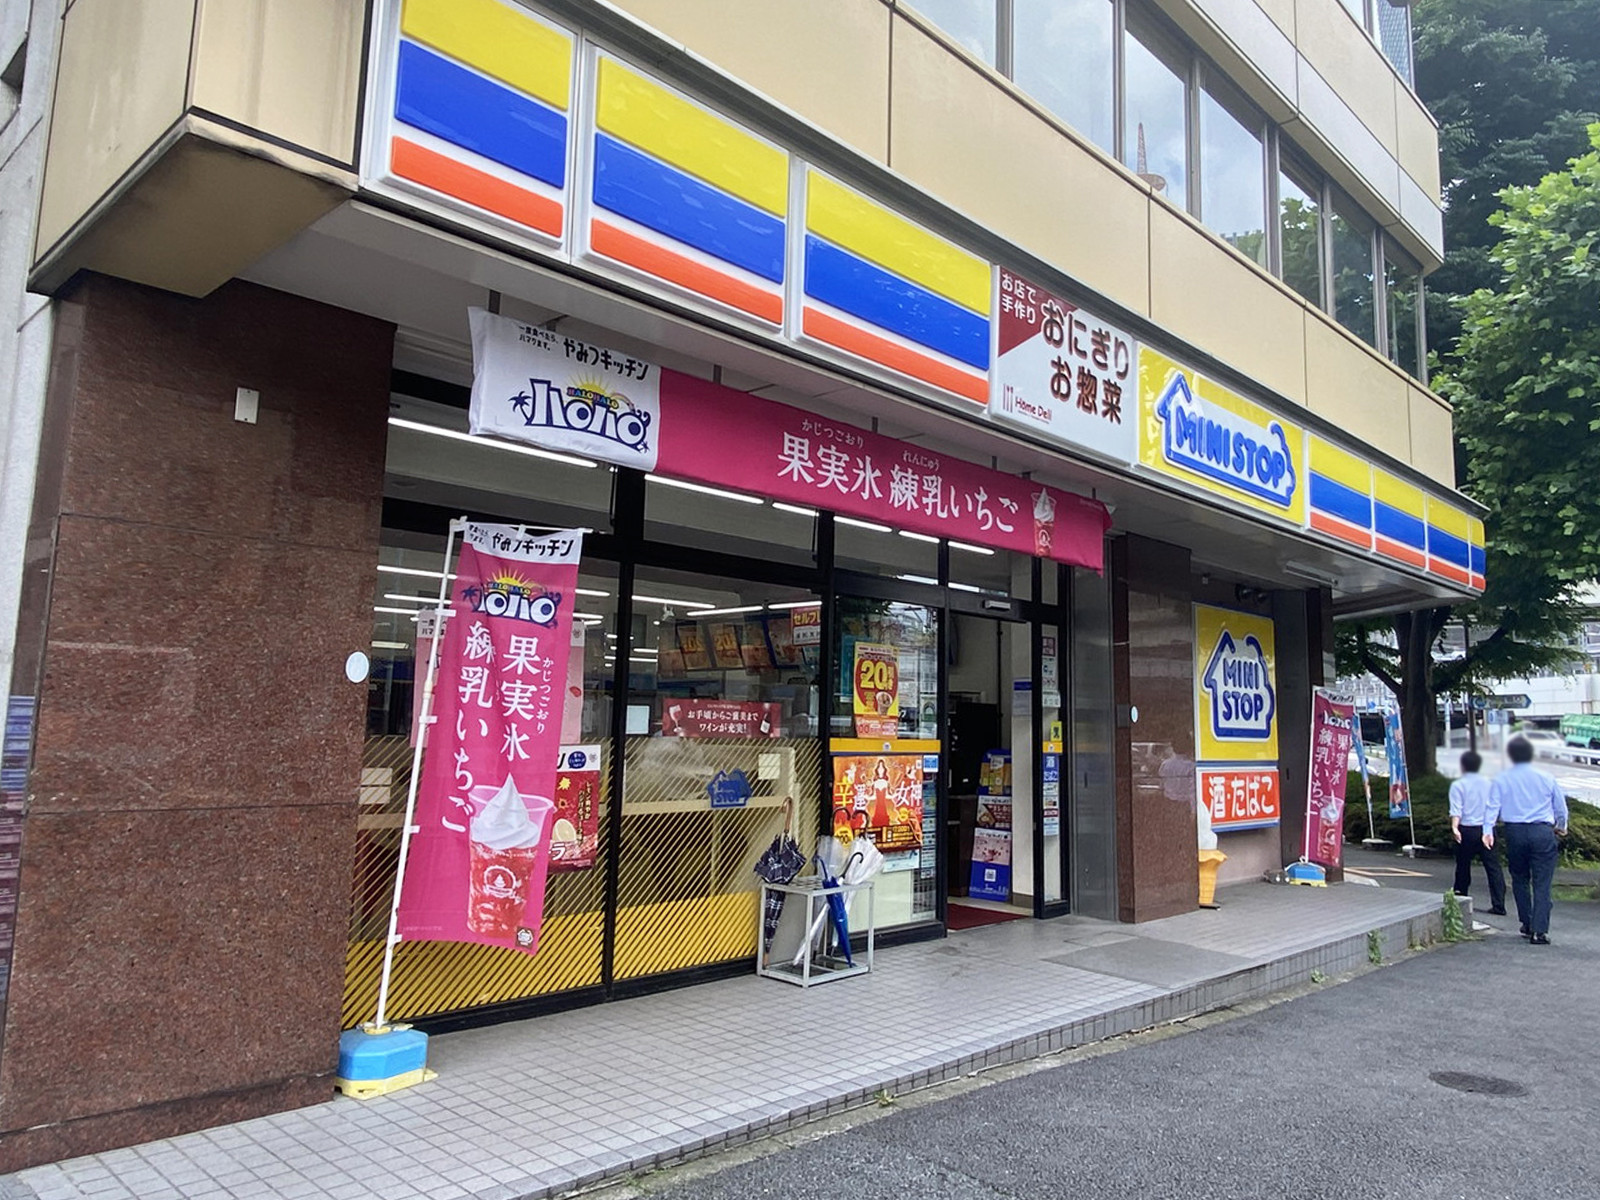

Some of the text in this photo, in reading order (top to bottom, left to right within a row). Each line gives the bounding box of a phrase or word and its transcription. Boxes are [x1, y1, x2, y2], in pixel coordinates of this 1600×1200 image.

[1001, 272, 1037, 305] お店で
[1001, 293, 1036, 325] 手作り
[563, 337, 649, 381] やみつキッチン
[1041, 299, 1130, 380] おにぎり
[566, 386, 620, 410] HALOHALO
[1014, 395, 1037, 416] Home
[1049, 355, 1123, 426] お惣菜
[902, 448, 941, 473] れんにゅう
[1175, 405, 1286, 489] MINISTOP
[777, 431, 1019, 534] 果実氷 練乳いちご
[1222, 658, 1260, 691] MINI
[501, 634, 543, 762] 果実氷
[1222, 690, 1264, 722] STOP
[441, 620, 496, 833] 練乳いちご
[1330, 733, 1350, 785] 果実氷
[1209, 774, 1275, 820] 酒・たばこ
